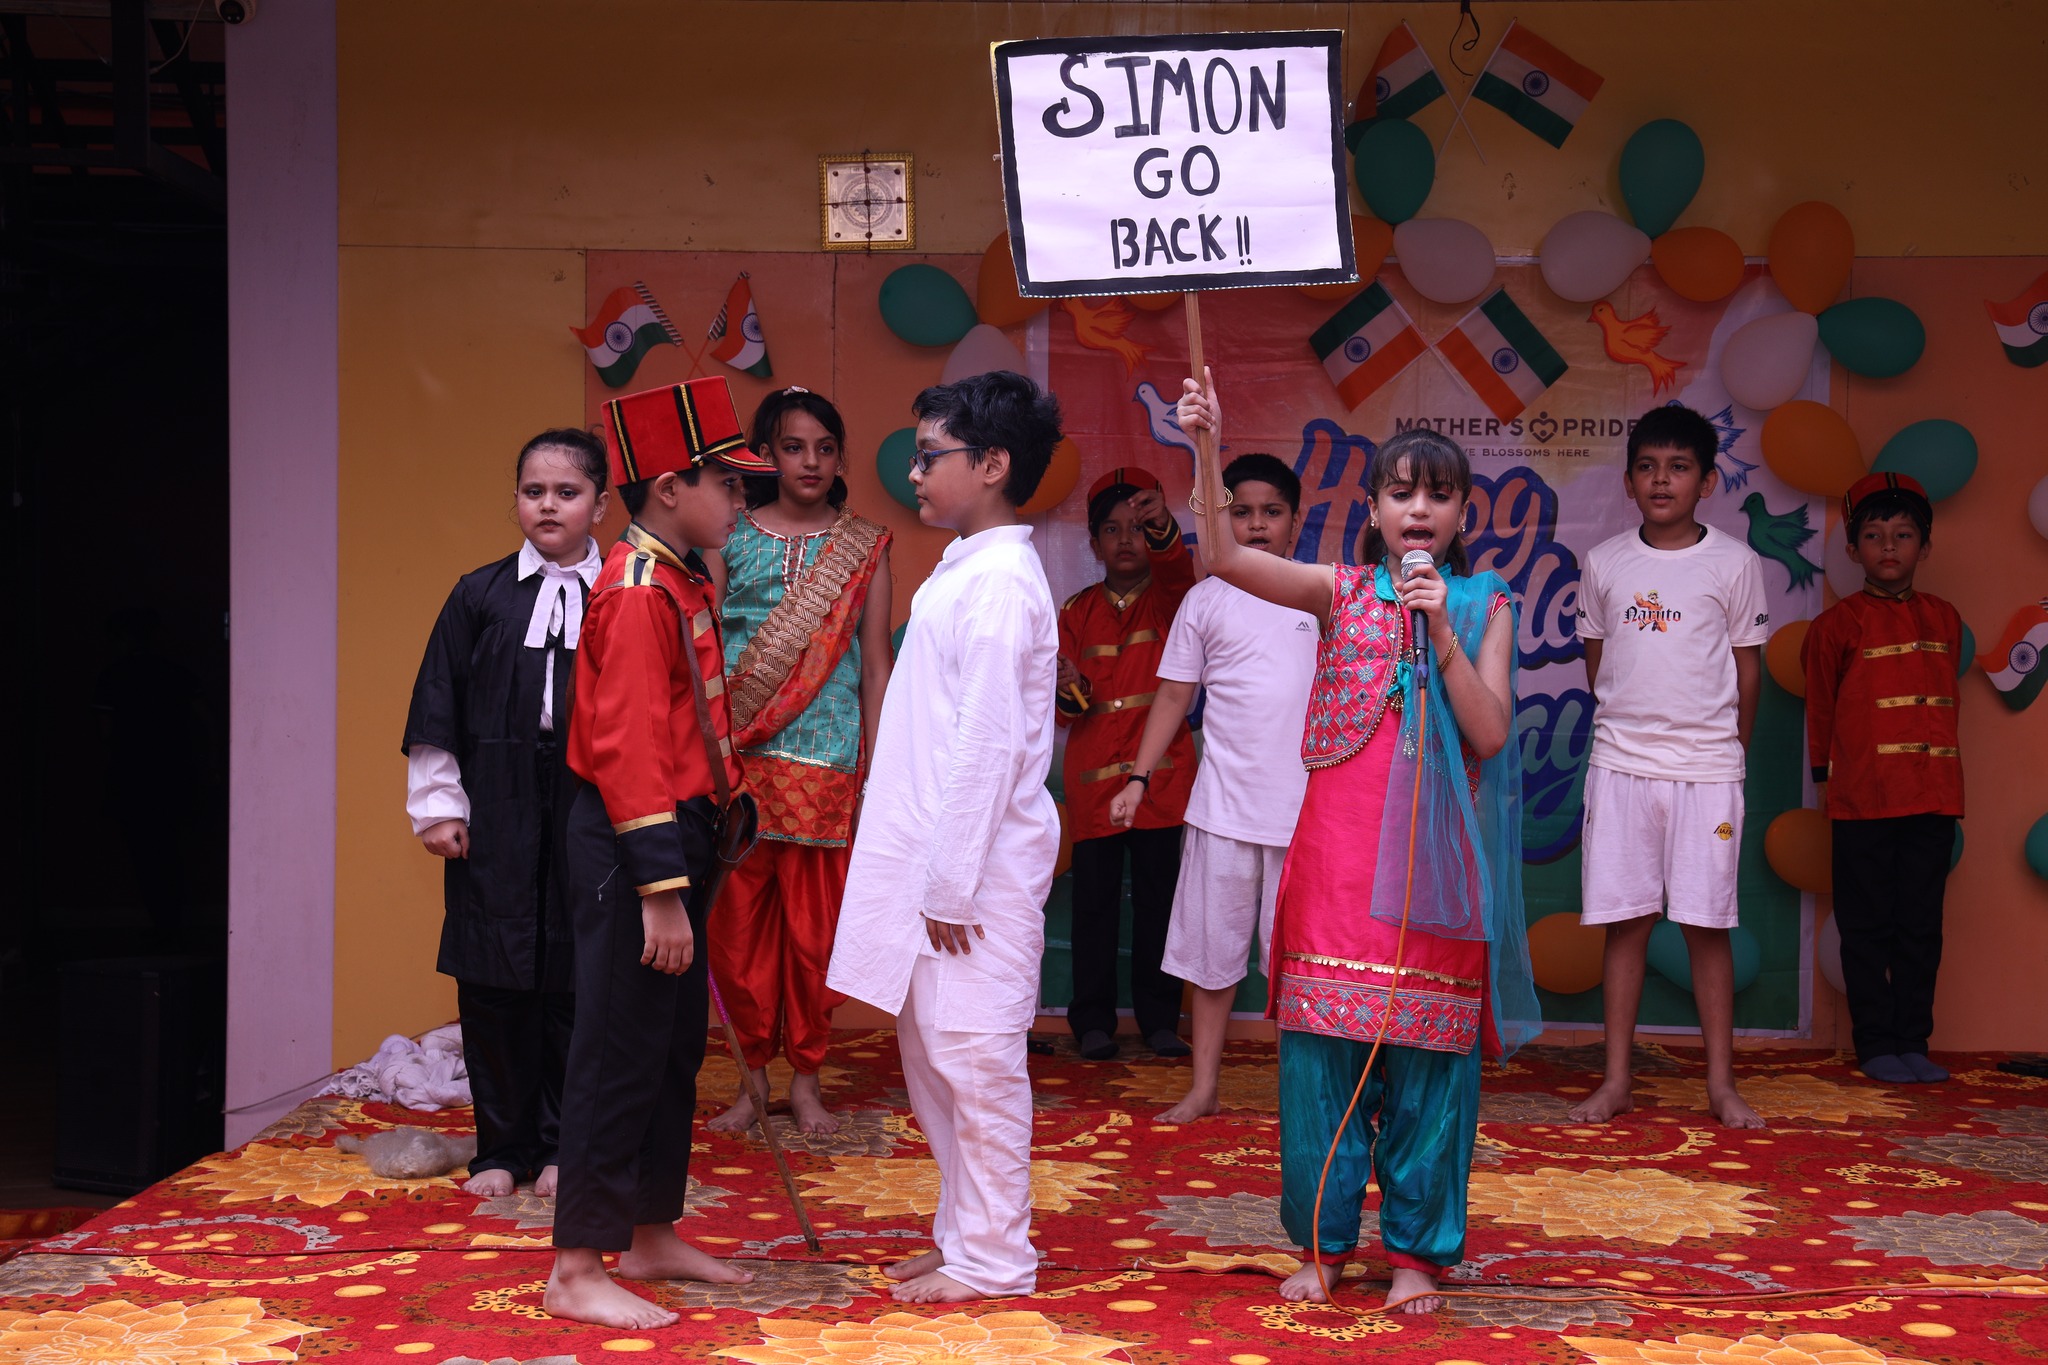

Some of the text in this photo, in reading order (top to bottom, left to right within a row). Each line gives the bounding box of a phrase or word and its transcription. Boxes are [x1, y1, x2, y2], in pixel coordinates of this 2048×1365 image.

[1042, 53, 1287, 138] SIMON
[1133, 144, 1221, 199] GO
[1395, 416, 1524, 437] MOTHERS
[1482, 447, 1551, 458] BLOSSOMS
[1557, 448, 1591, 458] HERE
[1622, 605, 1682, 624] Naruto
